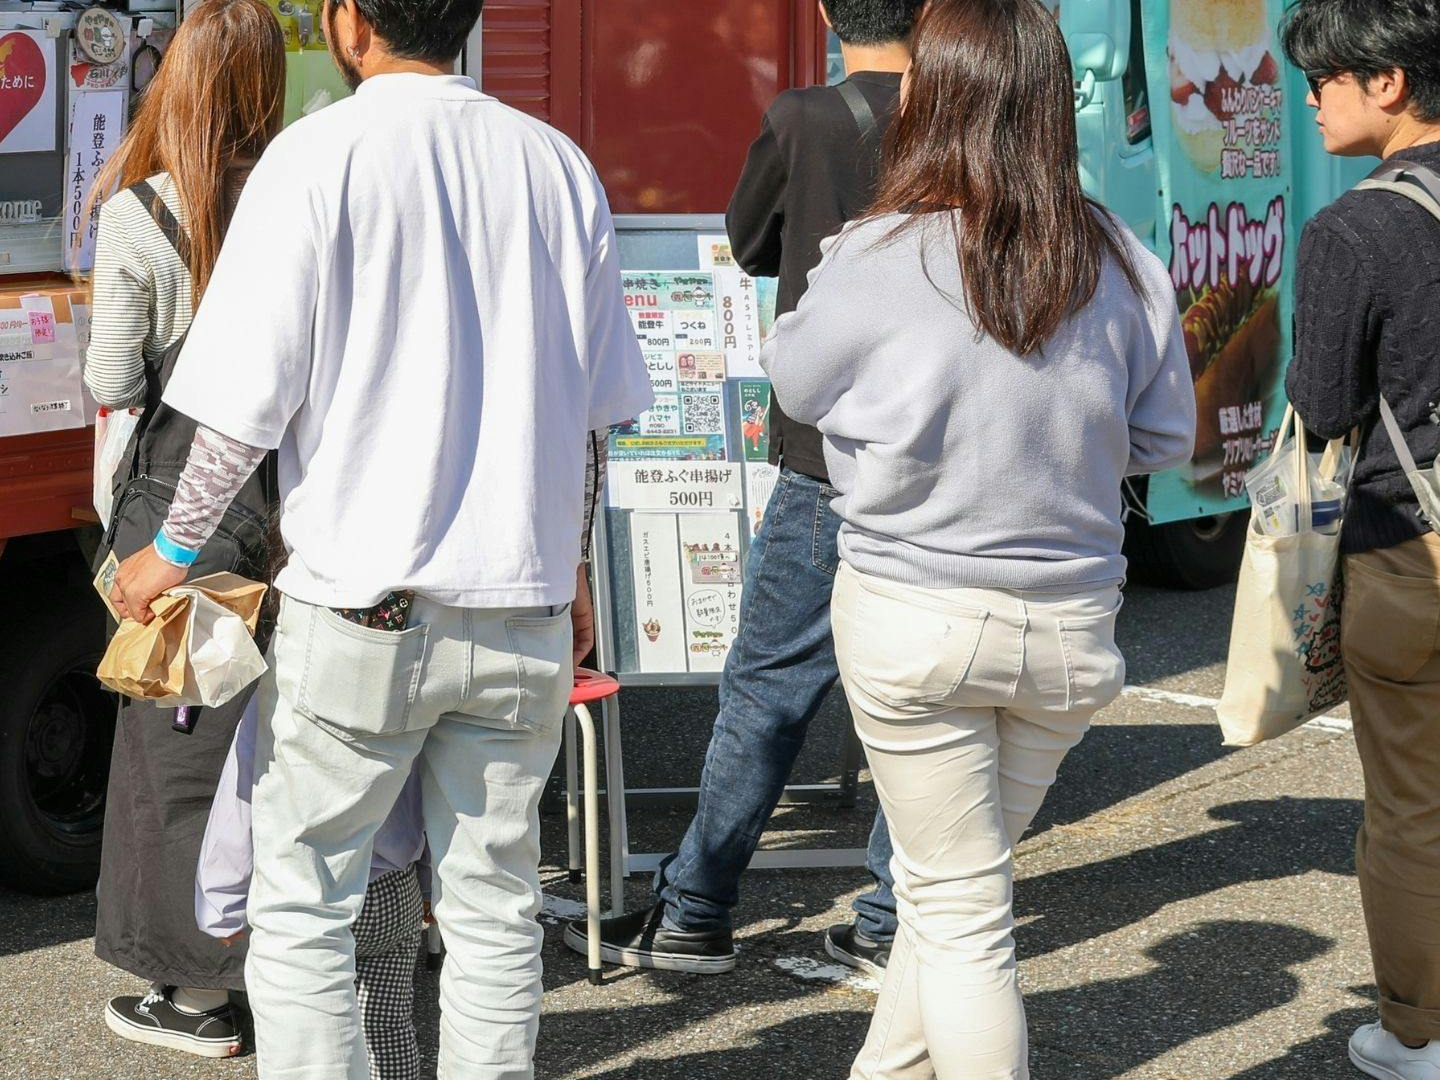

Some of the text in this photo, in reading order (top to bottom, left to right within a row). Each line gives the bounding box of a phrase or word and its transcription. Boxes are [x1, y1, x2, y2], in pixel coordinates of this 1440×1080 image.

[1222, 118, 1280, 146] フルーツをサンド
[70, 151, 85, 248] 1本500円
[1170, 196, 1284, 292] ホットドッグ
[623, 294, 657, 307] enu
[638, 320, 664, 329] 能登牛
[680, 321, 706, 330] つくね
[722, 295, 737, 349] 800円
[647, 338, 670, 346] 800円
[646, 361, 674, 371] としし
[648, 414, 671, 422] ハマヤ
[634, 468, 732, 484] 能登ふぐ串揚げ
[669, 491, 713, 507] 500円
